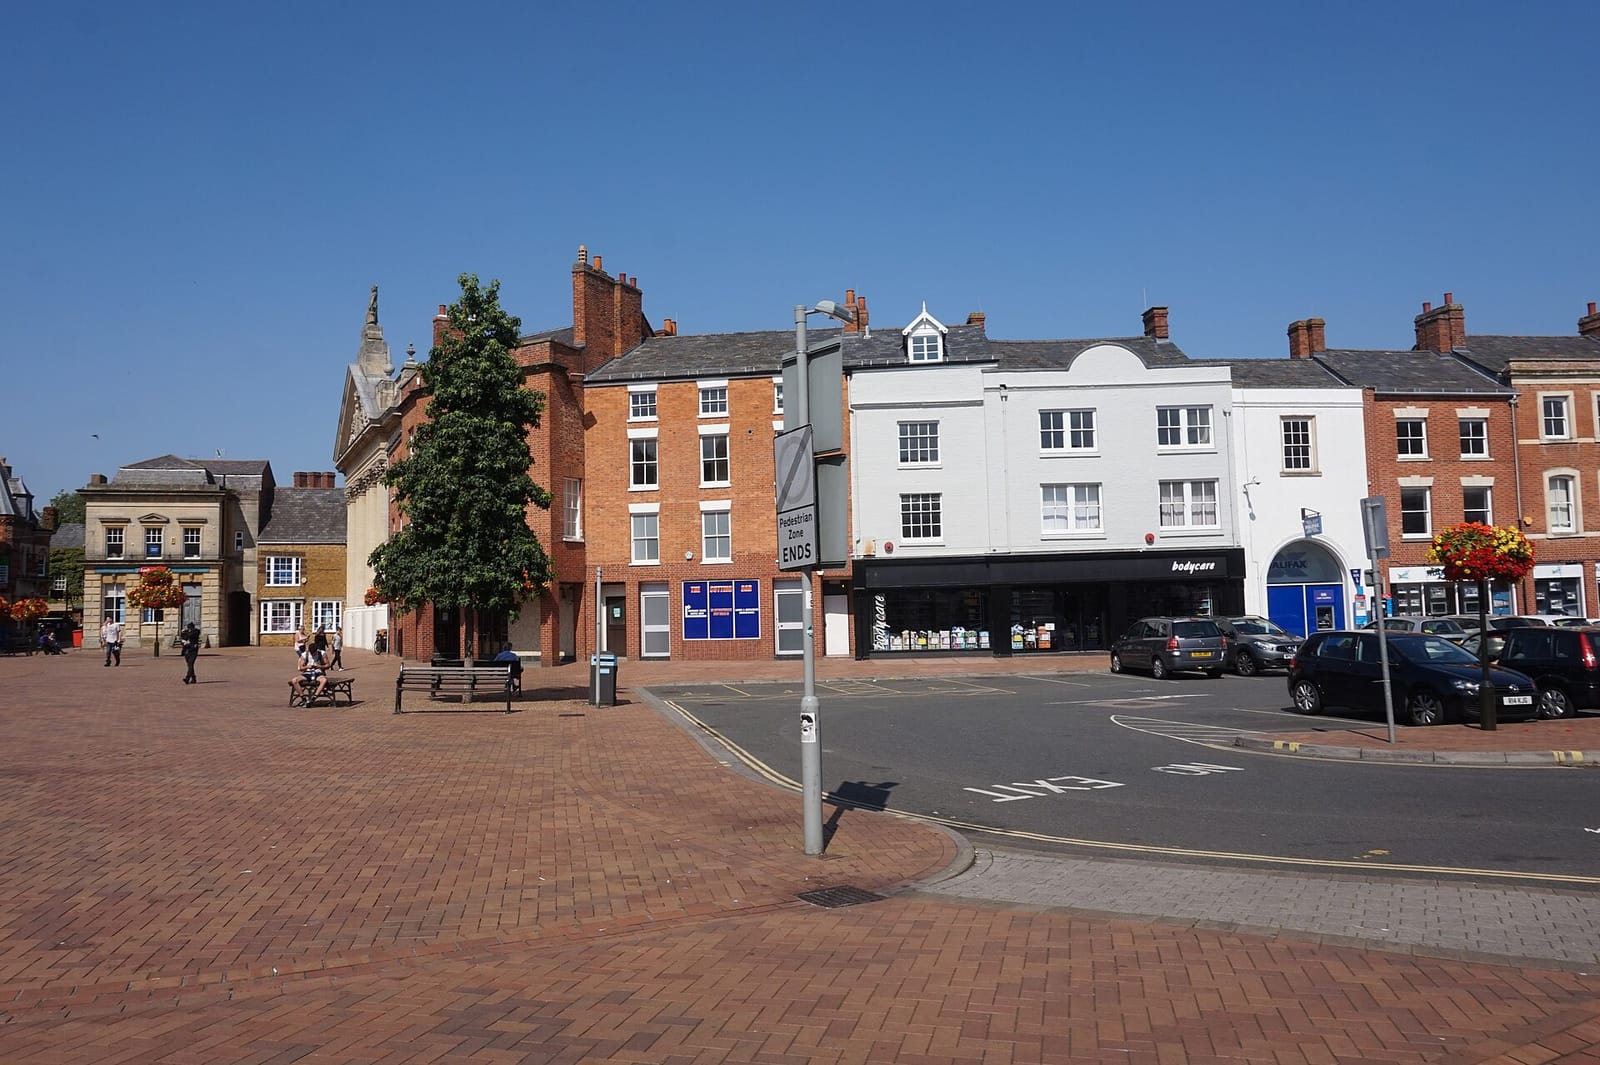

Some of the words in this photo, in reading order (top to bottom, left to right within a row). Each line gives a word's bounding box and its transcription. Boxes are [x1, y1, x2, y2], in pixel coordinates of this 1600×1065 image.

[779, 512, 813, 529] Pedestrian
[788, 528, 804, 540] Zone
[782, 542, 812, 563] ENDS
[1171, 560, 1216, 575] bodycare
[873, 594, 891, 652] bodycare
[962, 775, 1127, 803] EXIT
